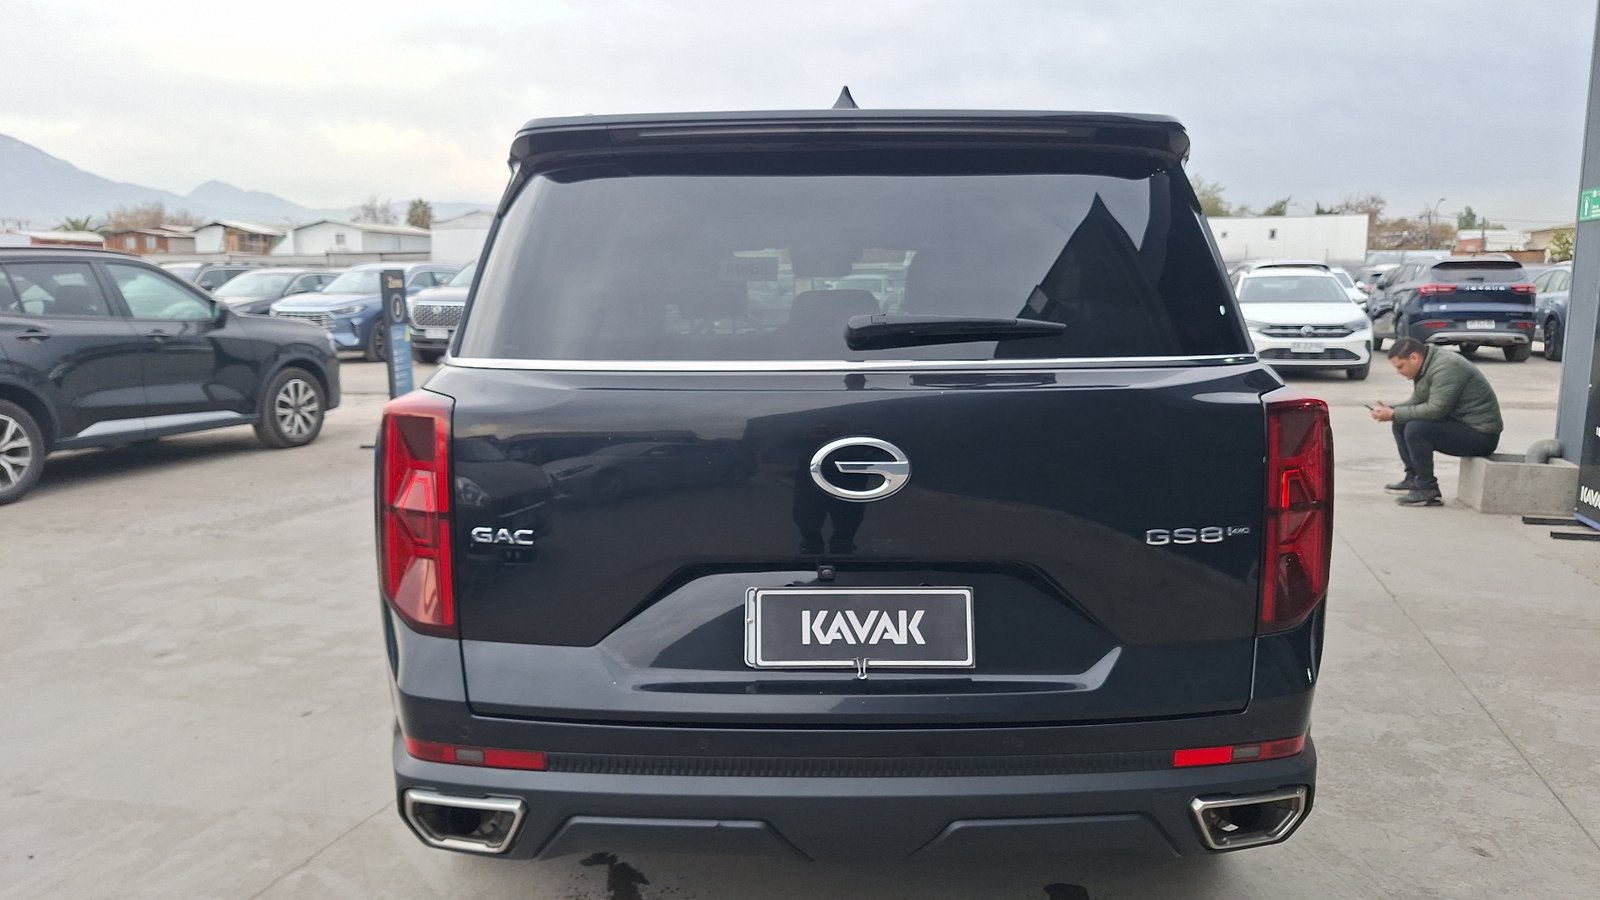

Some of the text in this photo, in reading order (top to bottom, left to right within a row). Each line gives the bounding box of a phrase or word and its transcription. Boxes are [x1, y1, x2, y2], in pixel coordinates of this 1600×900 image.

[471, 527, 534, 545] GAC
[1146, 526, 1224, 545] GS8
[802, 610, 926, 645] KAVAK
